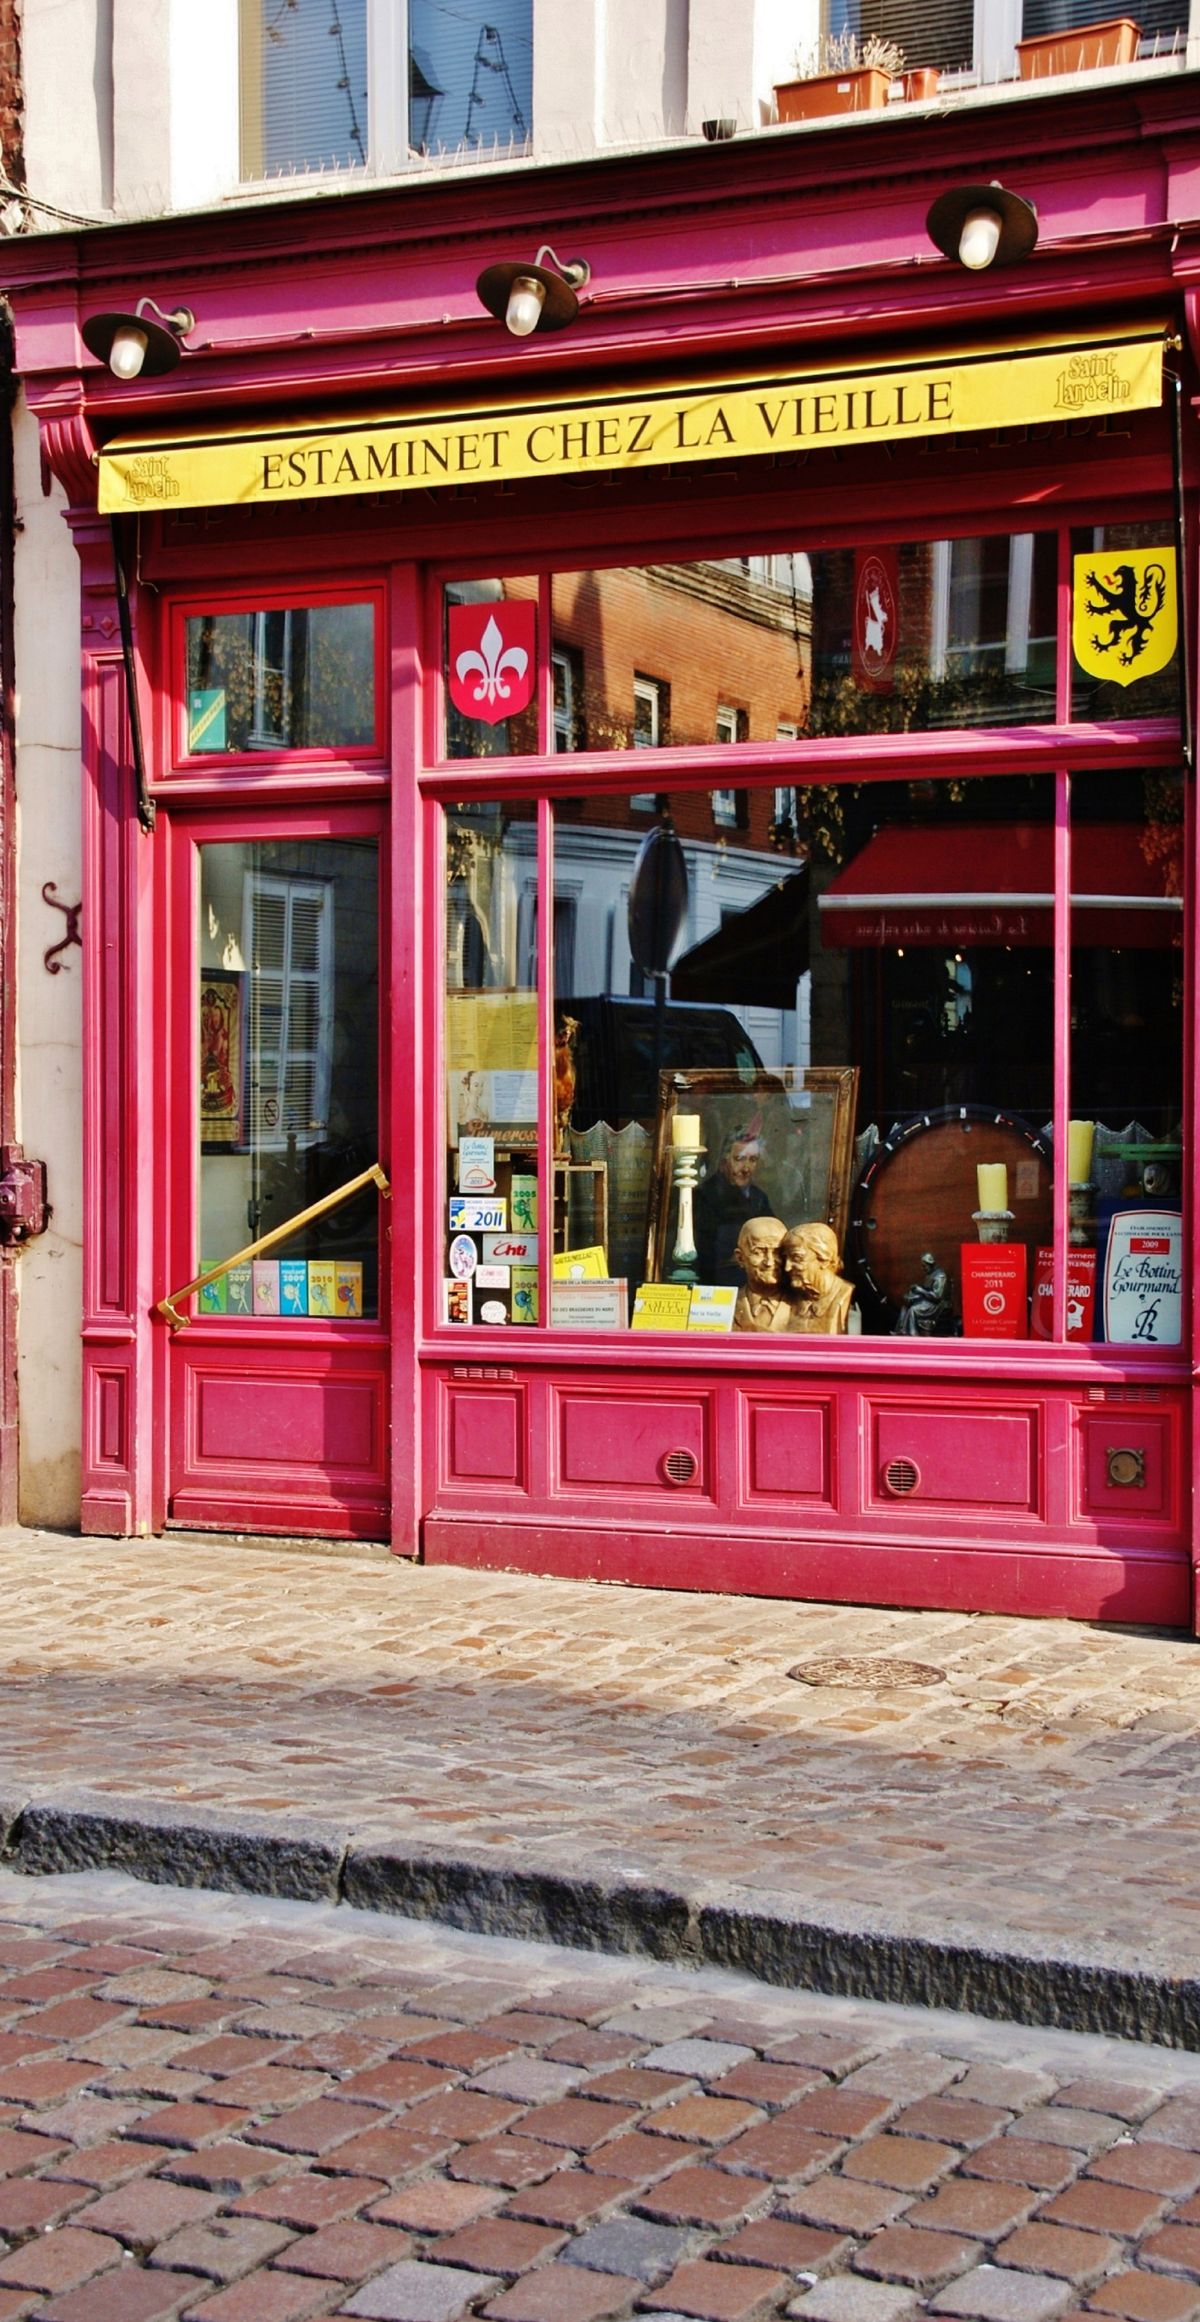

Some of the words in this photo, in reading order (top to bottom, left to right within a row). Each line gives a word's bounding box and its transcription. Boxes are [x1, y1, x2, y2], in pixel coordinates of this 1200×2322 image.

[1067, 352, 1117, 379] Saint
[1053, 371, 1130, 411] Landelin
[262, 431, 506, 490] ESTAMINET
[525, 414, 653, 463] CHEZ
[675, 409, 737, 448] LA
[756, 380, 954, 438] VIEILLE
[132, 456, 169, 478] Saint
[123, 470, 179, 505] Landelin
[513, 1190, 536, 1198] 2005
[474, 1211, 503, 1227] 2011
[1141, 1240, 1158, 1249] 2009
[282, 1274, 304, 1282] 2009
[1113, 1254, 1133, 1278] Le
[1135, 1256, 1183, 1280] Bottin
[983, 1280, 1003, 1288] 2011
[1110, 1276, 1183, 1300] Gourmand
